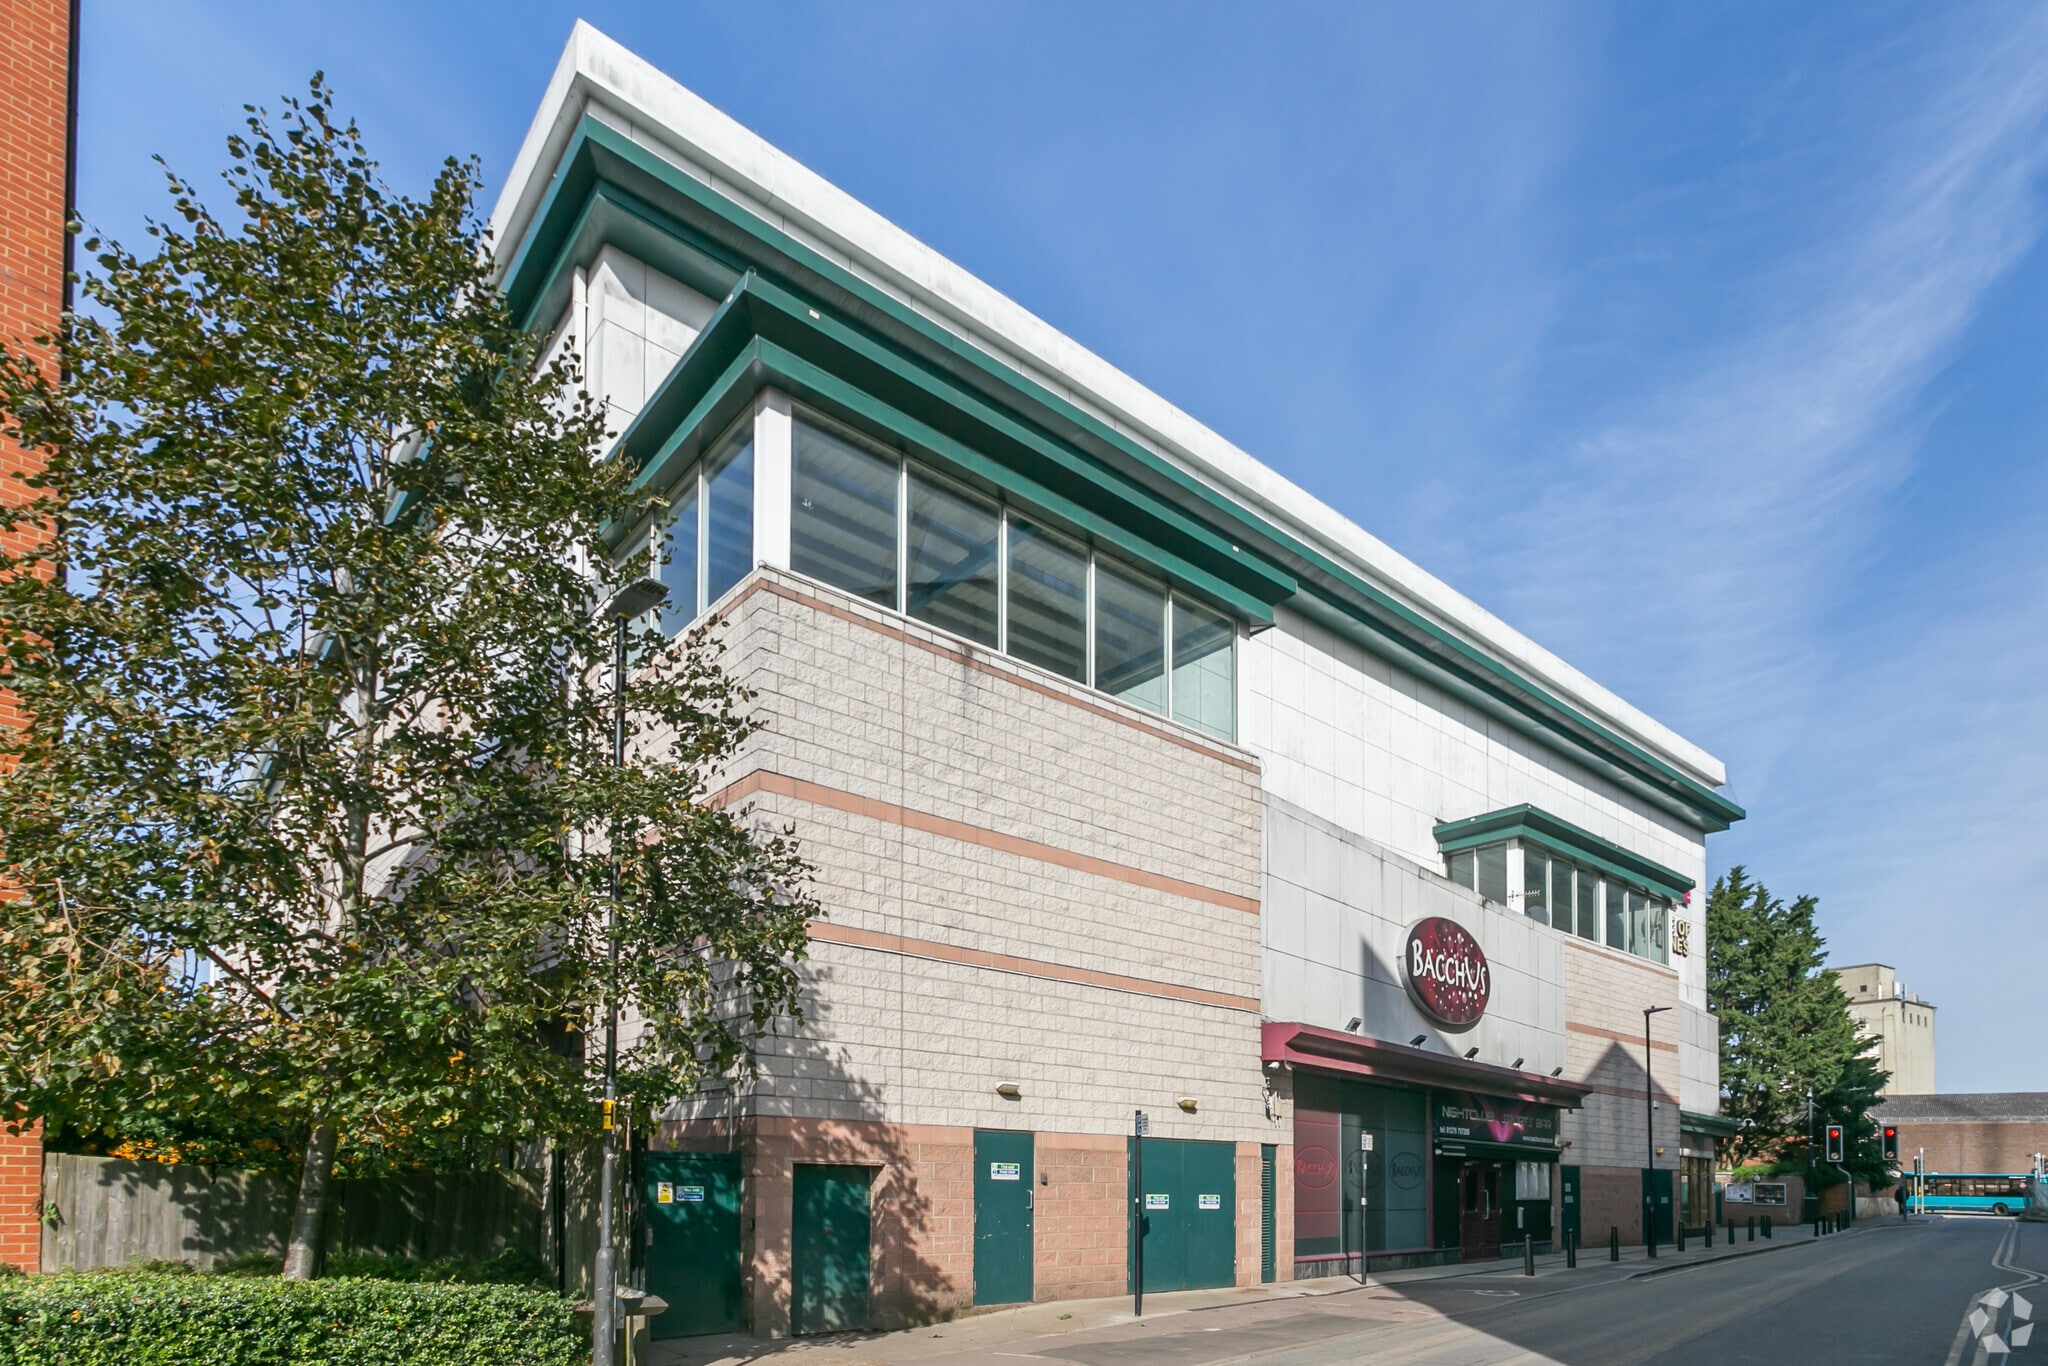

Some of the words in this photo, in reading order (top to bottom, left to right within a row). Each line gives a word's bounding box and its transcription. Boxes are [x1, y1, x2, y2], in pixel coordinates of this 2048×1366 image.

[1411, 938, 1488, 996] BACCHUS
[1441, 1105, 1494, 1122] NIGHTCLUB
[1535, 1118, 1552, 1130] BAR
[1296, 1157, 1336, 1178] BACCHUS
